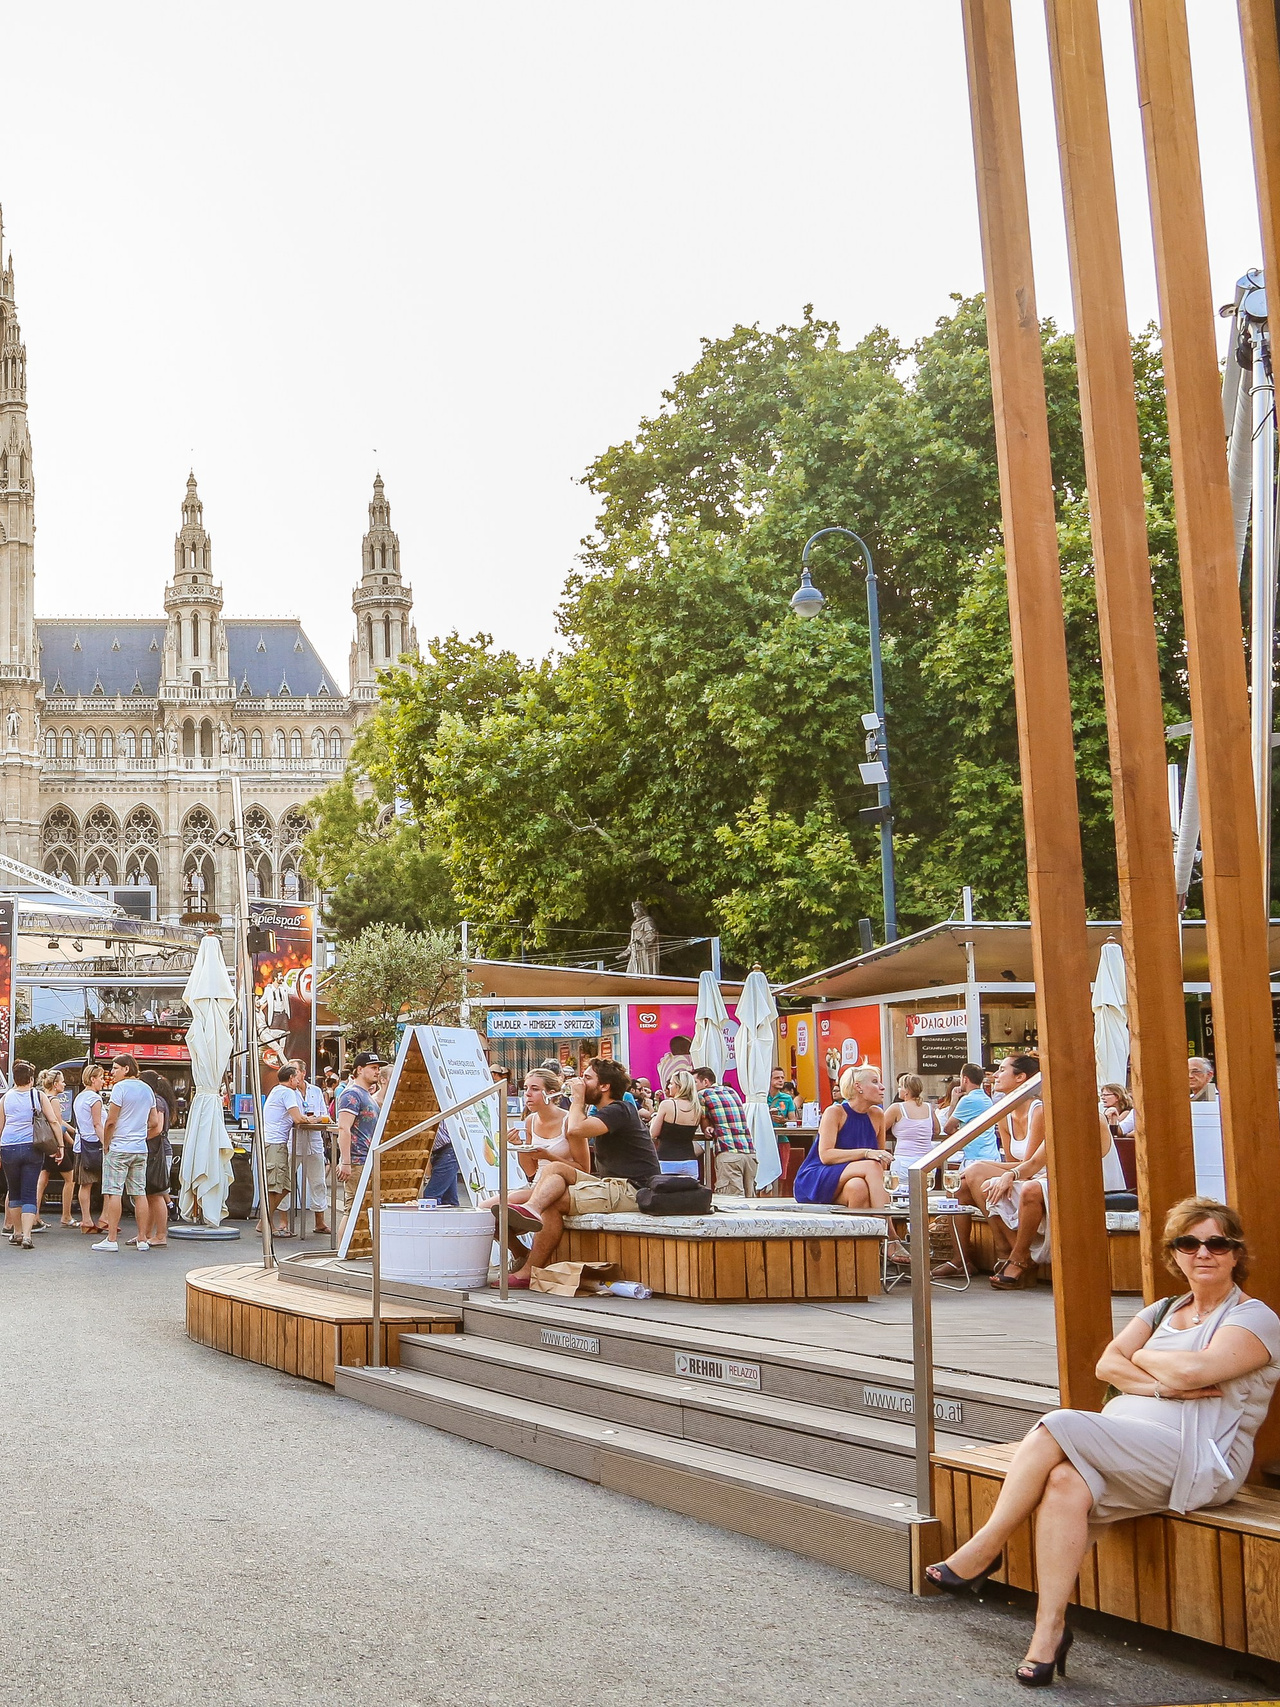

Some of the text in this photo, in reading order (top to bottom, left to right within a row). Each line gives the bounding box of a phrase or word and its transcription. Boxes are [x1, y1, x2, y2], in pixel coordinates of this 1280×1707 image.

[251, 911, 301, 927] Spielspaß
[493, 1019, 522, 1030] UHUDLER
[528, 1020, 556, 1030] HIMBEER
[563, 1020, 595, 1030] SPRITZER
[540, 1331, 599, 1354] www.relazzo.at
[688, 1357, 758, 1380] REHAU RELAZZO
[864, 1390, 963, 1422] www.relo.at
